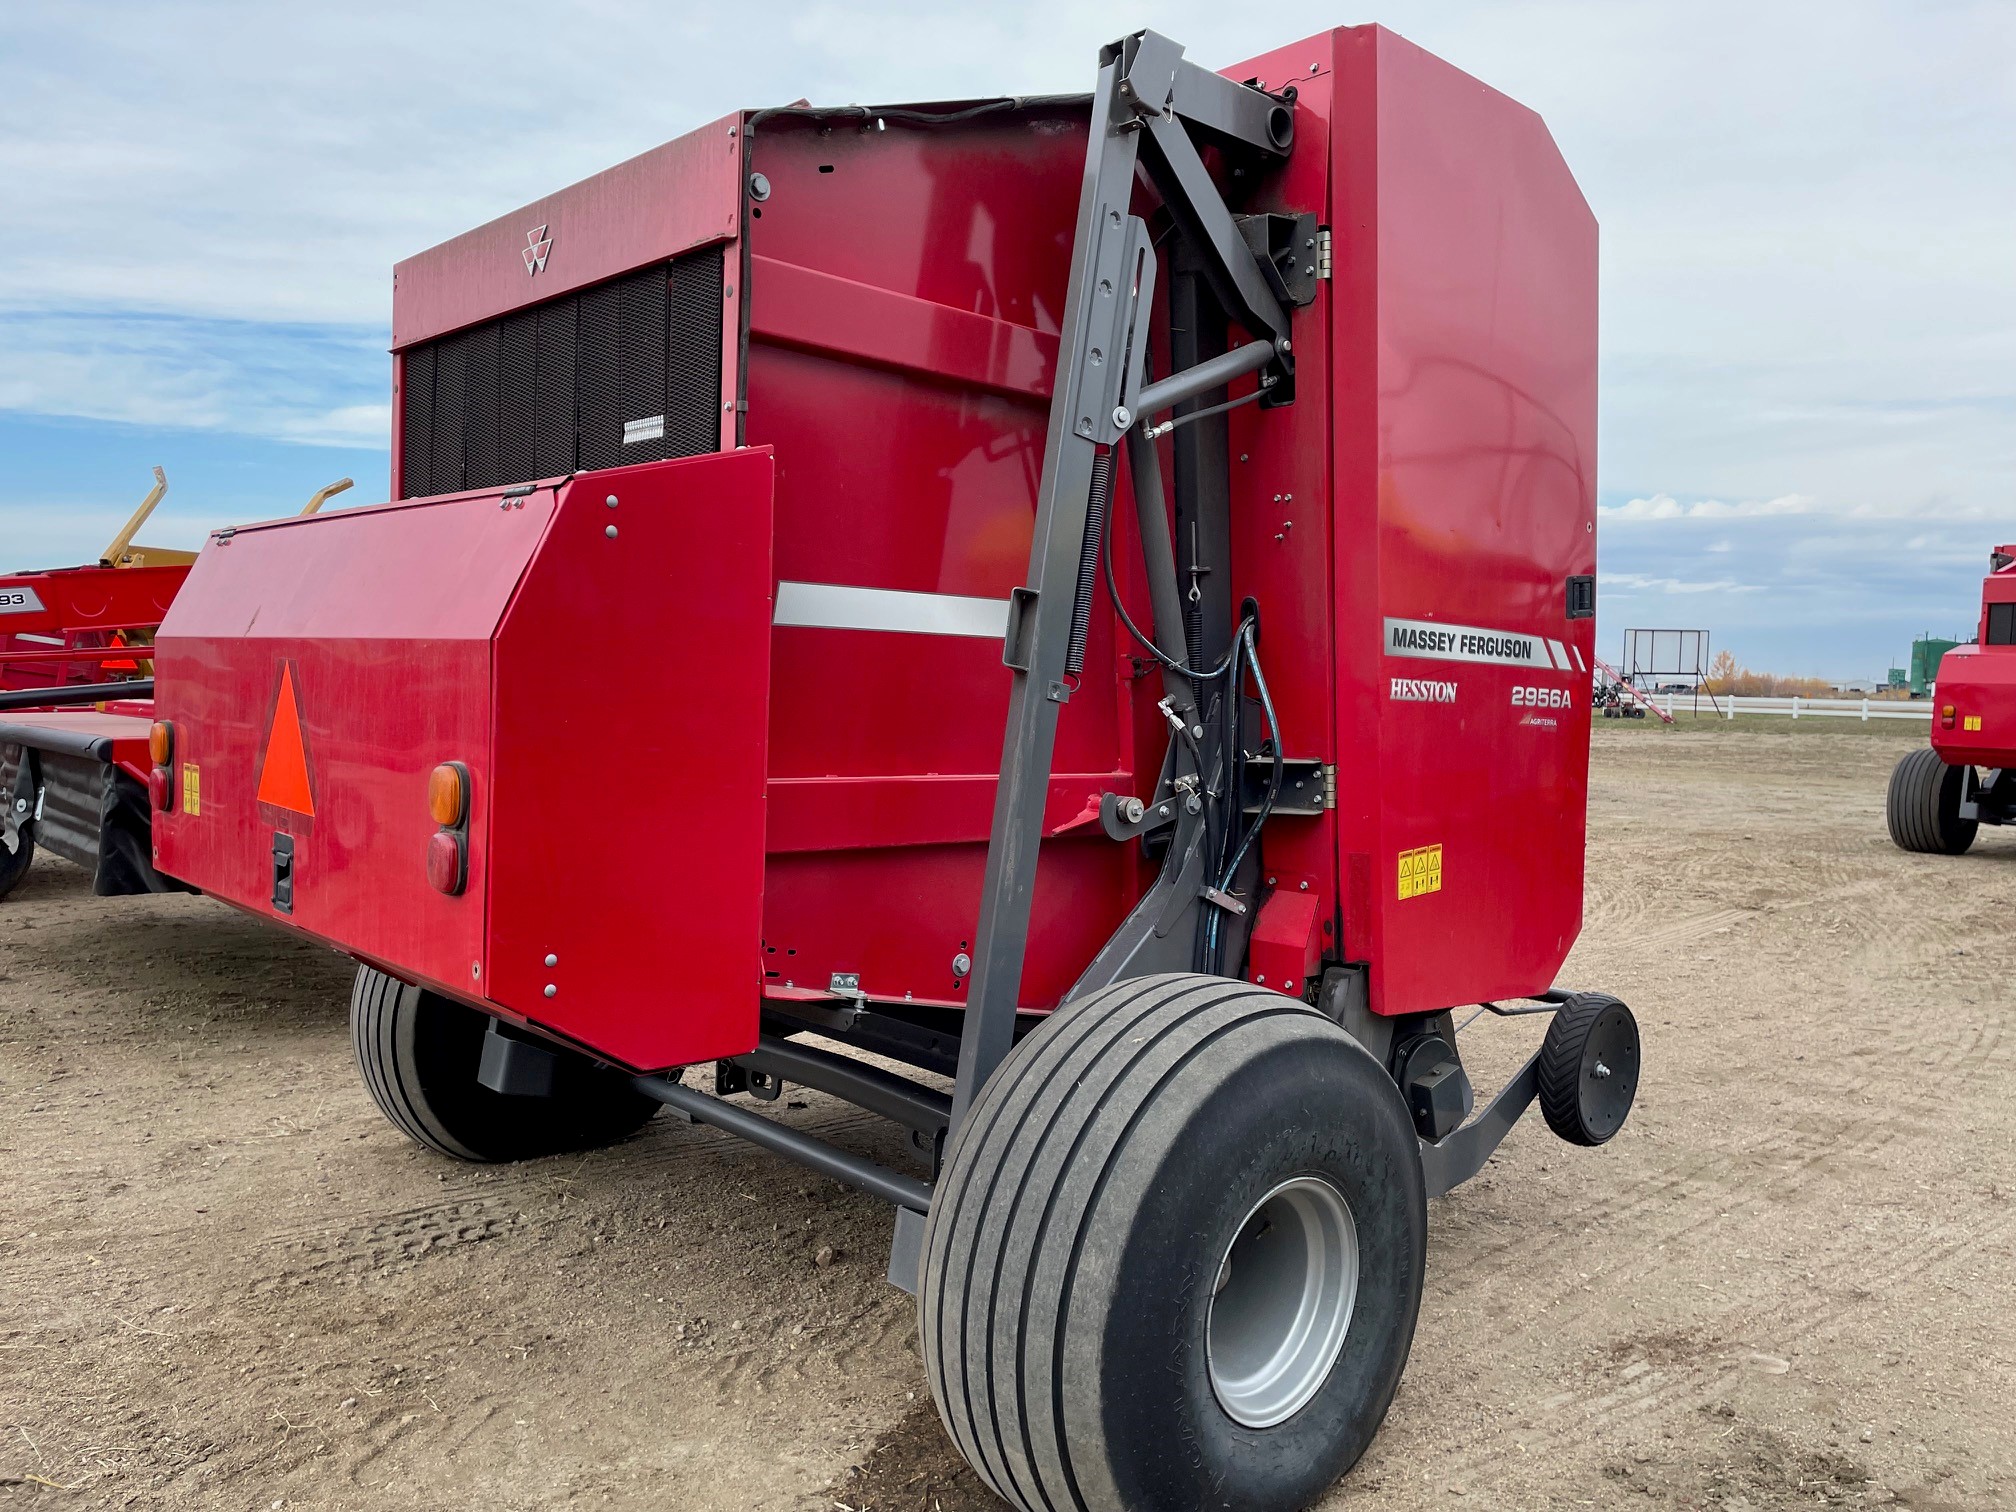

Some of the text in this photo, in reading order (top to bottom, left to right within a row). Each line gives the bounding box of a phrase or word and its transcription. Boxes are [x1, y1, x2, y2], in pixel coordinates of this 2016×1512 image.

[1392, 627, 1532, 659] MASSEY FERGUSON
[1389, 678, 1458, 703] HESSTON
[1511, 686, 1572, 709] 2956A
[1530, 718, 1557, 726] AGRITERRA
